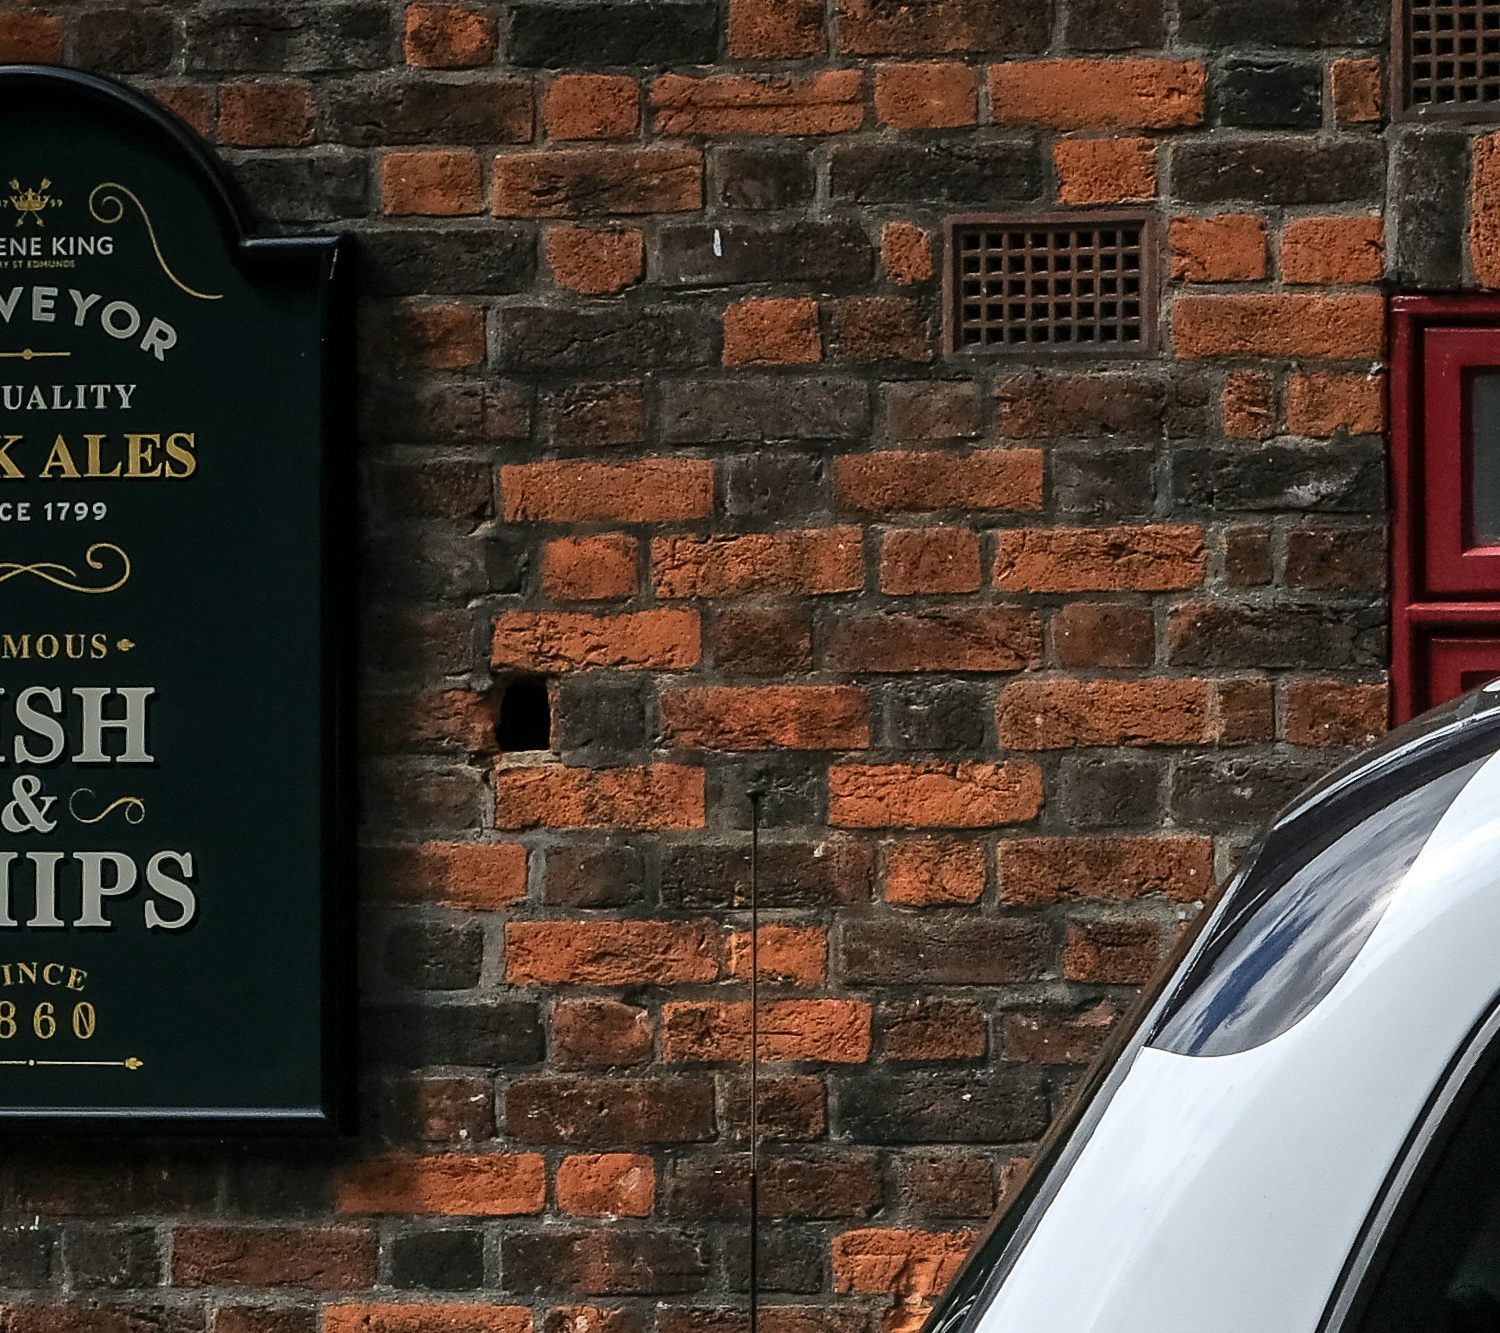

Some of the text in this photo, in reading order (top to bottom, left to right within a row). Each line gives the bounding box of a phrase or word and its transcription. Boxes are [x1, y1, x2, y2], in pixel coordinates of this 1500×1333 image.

[52, 235, 114, 256] KING
[12, 260, 23, 269] ST
[27, 259, 76, 269] EDMUNDS
[40, 433, 197, 479] ALES
[44, 502, 108, 521] 1799
[1, 775, 58, 833] &
